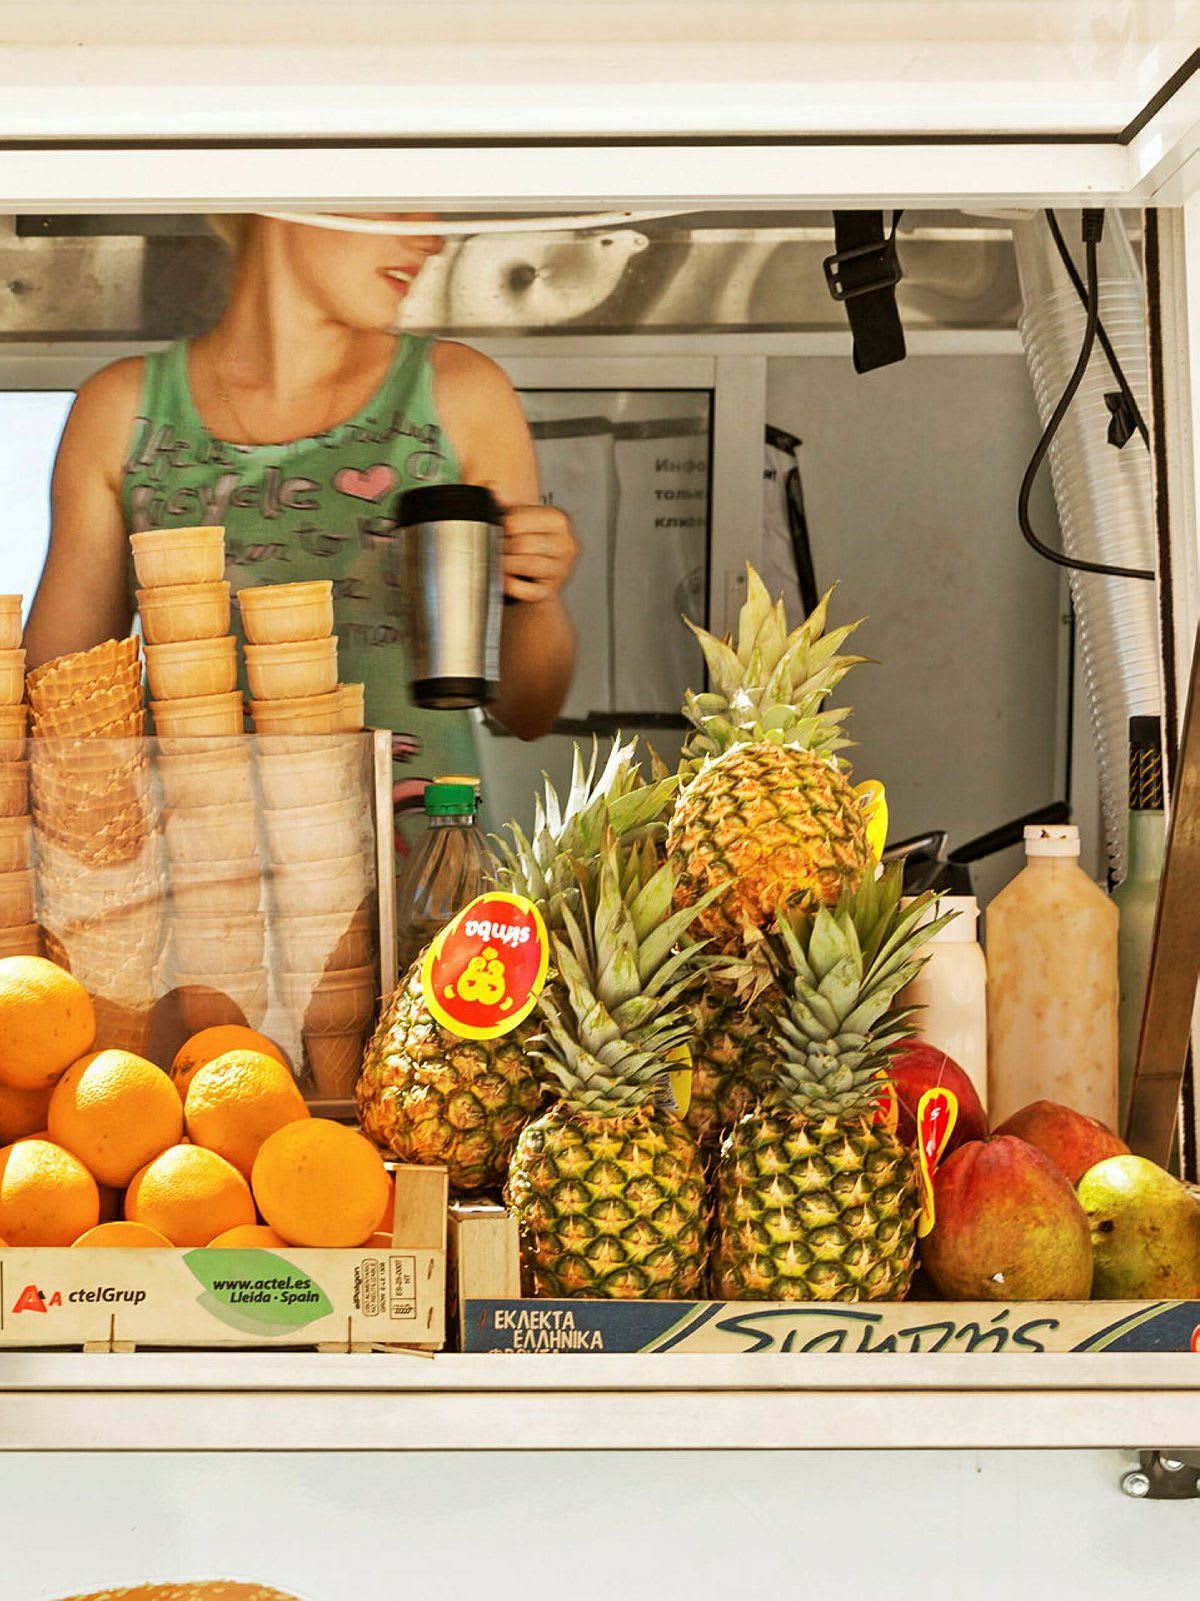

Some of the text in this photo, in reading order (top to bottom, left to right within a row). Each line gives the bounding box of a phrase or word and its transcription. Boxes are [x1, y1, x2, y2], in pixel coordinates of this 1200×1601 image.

[465, 920, 531, 948] simba
[212, 1277, 312, 1290] www.actel.es
[230, 1291, 319, 1305] Lleida Spain
[494, 1310, 576, 1329] ΕΚΛΕΚΤΑ
[513, 1330, 604, 1349] ΕΛΛΗΝΙΚΑ
